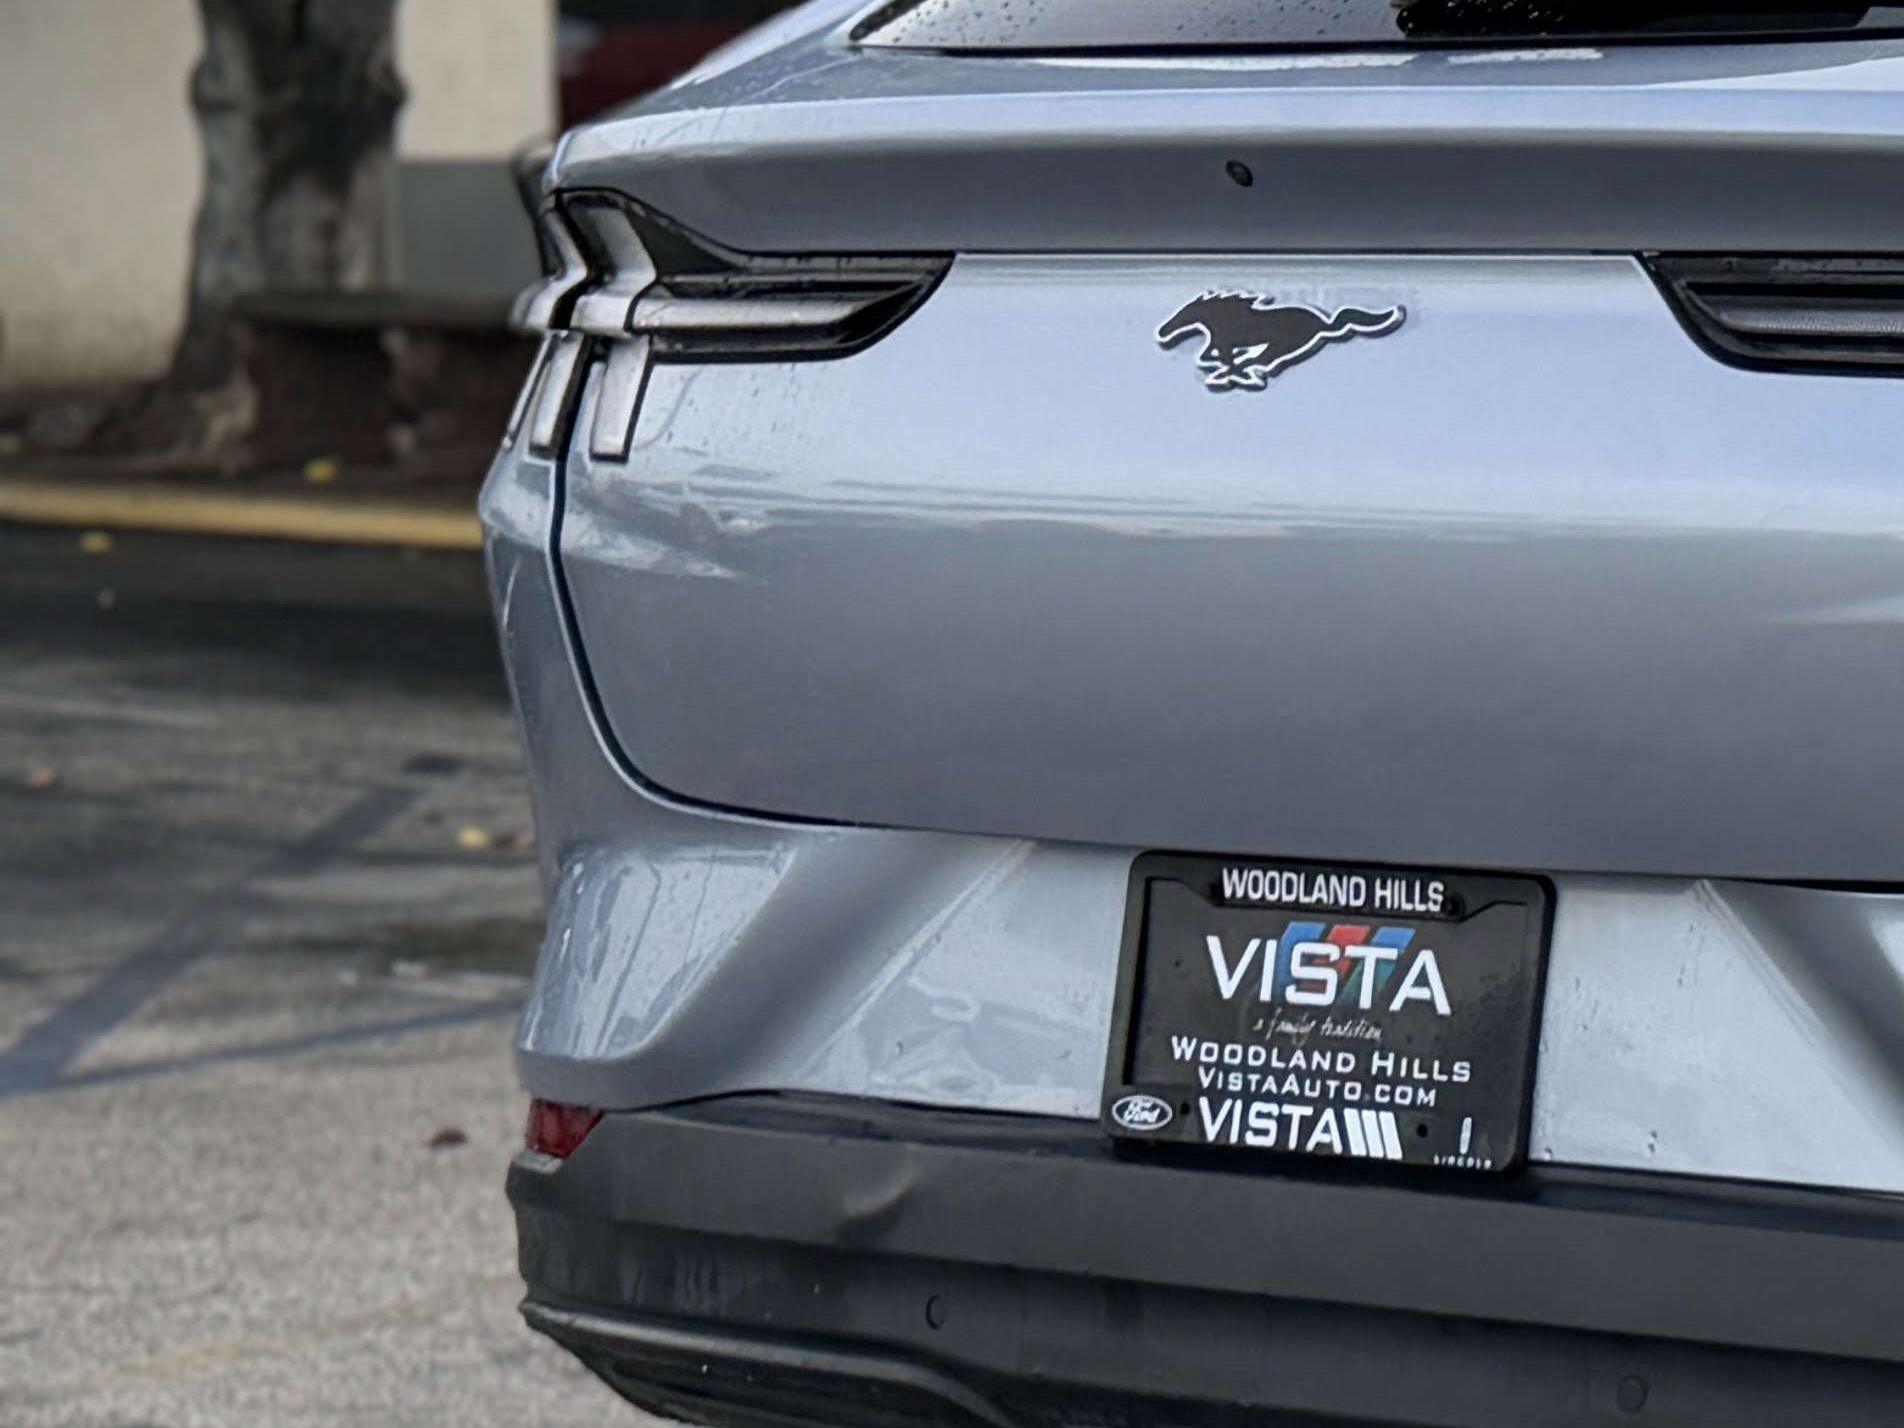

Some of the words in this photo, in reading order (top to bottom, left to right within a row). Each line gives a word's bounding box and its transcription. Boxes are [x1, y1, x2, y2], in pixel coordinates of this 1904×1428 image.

[1222, 867, 1367, 908] WOODLAND
[1373, 877, 1446, 913] HILLS
[1205, 934, 1452, 1017] VISTA
[1171, 1035, 1356, 1073] WOODLAND
[1371, 1050, 1472, 1083] HILLS
[1122, 1098, 1161, 1123] Ford
[1198, 1095, 1343, 1154] VISTA
